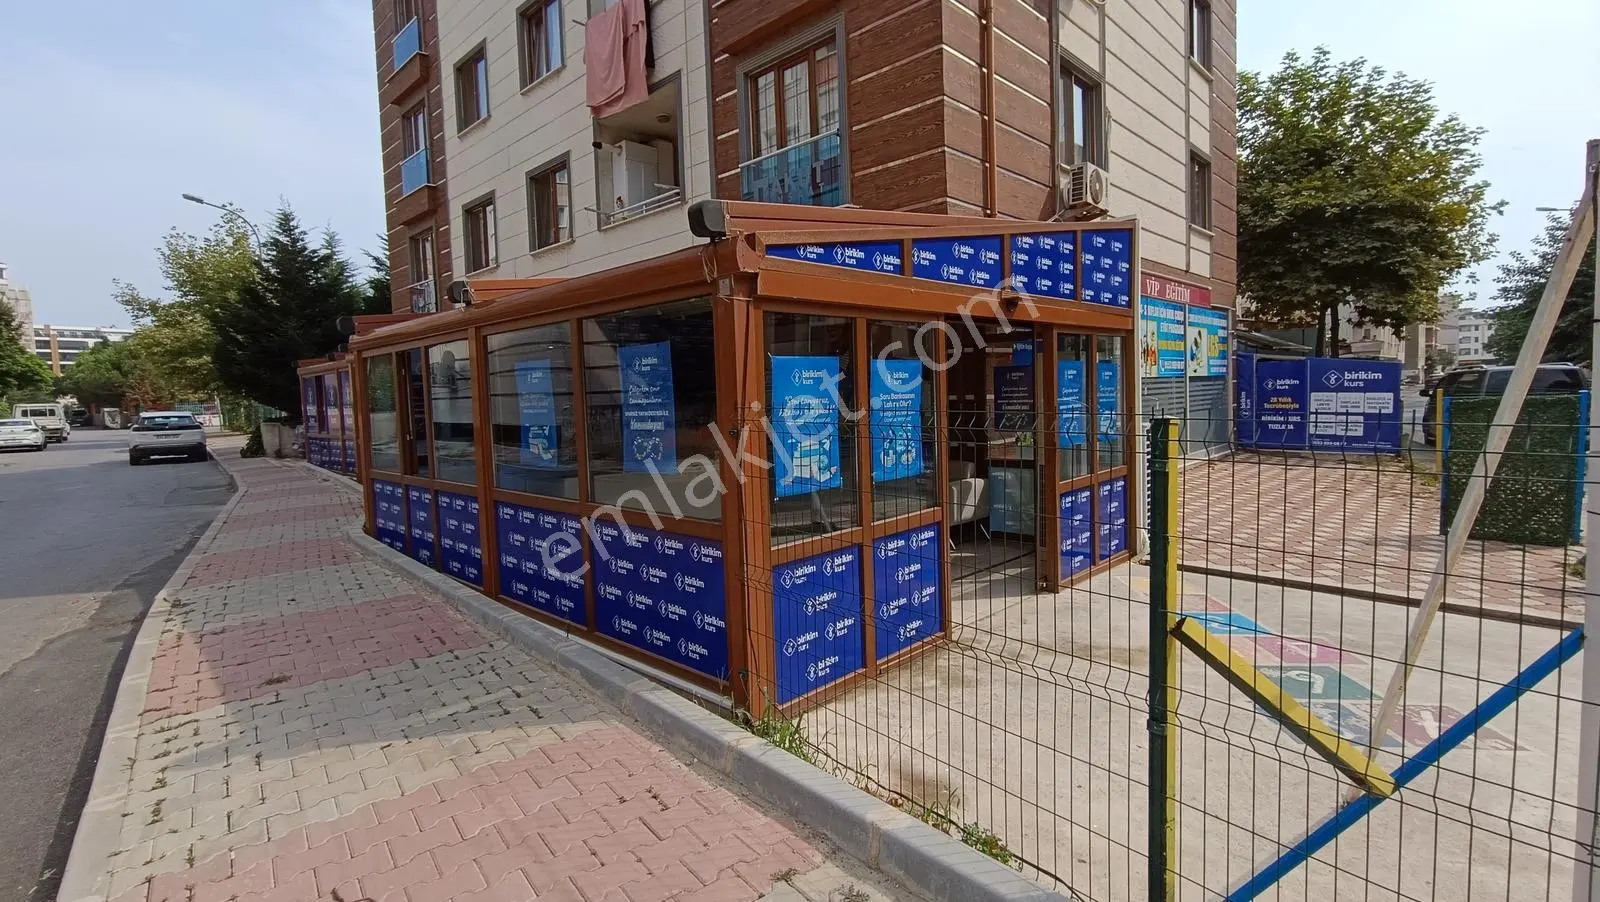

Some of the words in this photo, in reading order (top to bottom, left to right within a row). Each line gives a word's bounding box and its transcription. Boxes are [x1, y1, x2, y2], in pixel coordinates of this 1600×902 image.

[807, 246, 824, 254] birikim
[845, 247, 864, 258] birikim
[884, 255, 900, 264] birikim
[1146, 277, 1160, 296] VİP
[1166, 282, 1190, 302] EĞİTİM
[1344, 371, 1382, 380] birikim
